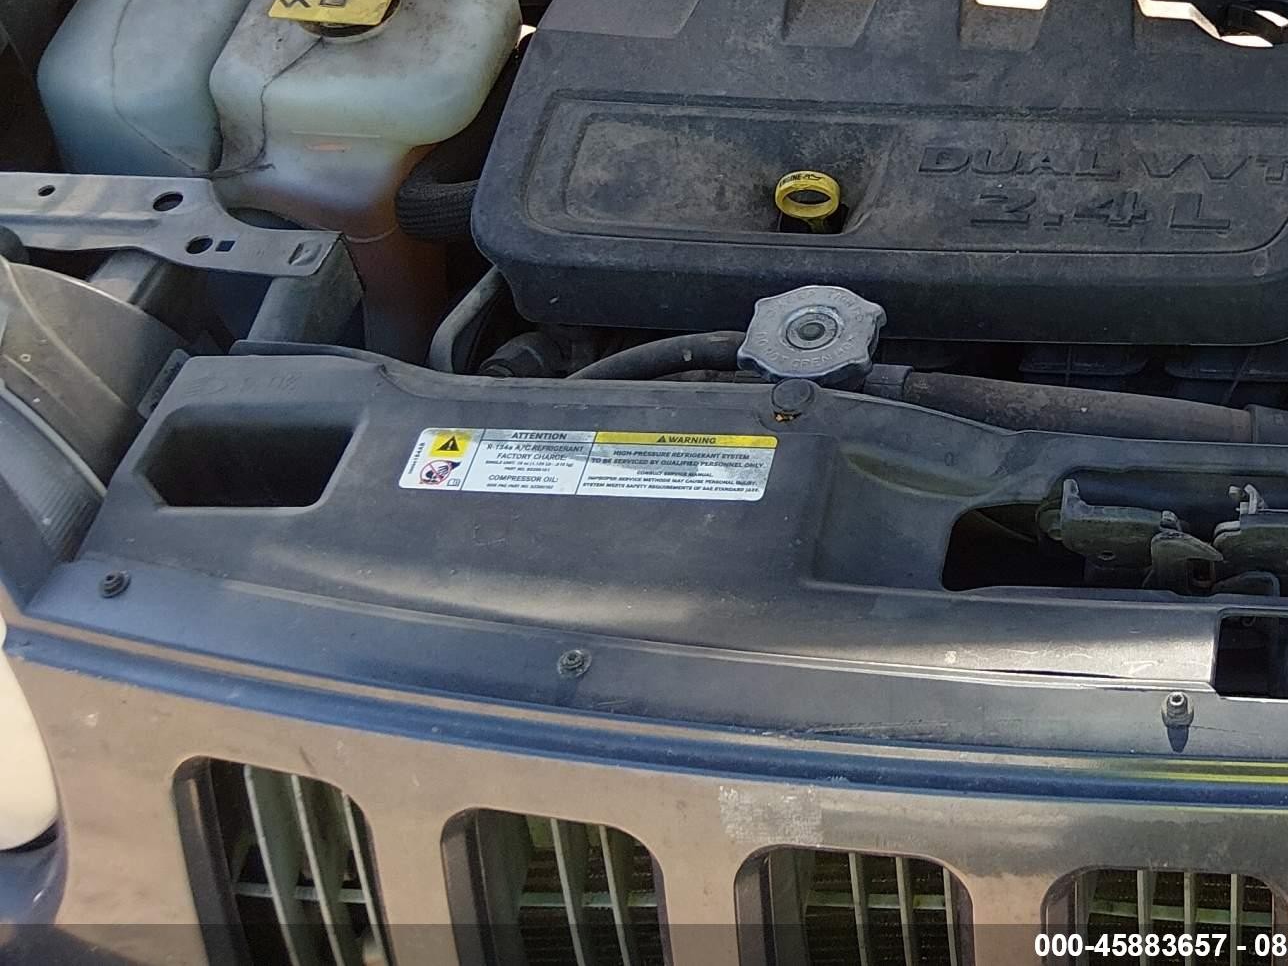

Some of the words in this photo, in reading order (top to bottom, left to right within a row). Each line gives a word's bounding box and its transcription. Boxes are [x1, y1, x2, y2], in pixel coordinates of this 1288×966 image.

[917, 146, 1121, 182] DUAL
[970, 187, 1232, 231] 2.4L
[791, 353, 833, 369] OPEN
[511, 432, 568, 440] ATTENTION
[668, 435, 717, 444] WARNING
[497, 452, 533, 460] FACTORY
[672, 451, 721, 459] REFRIGERANT
[488, 474, 542, 482] COMPRESSOR
